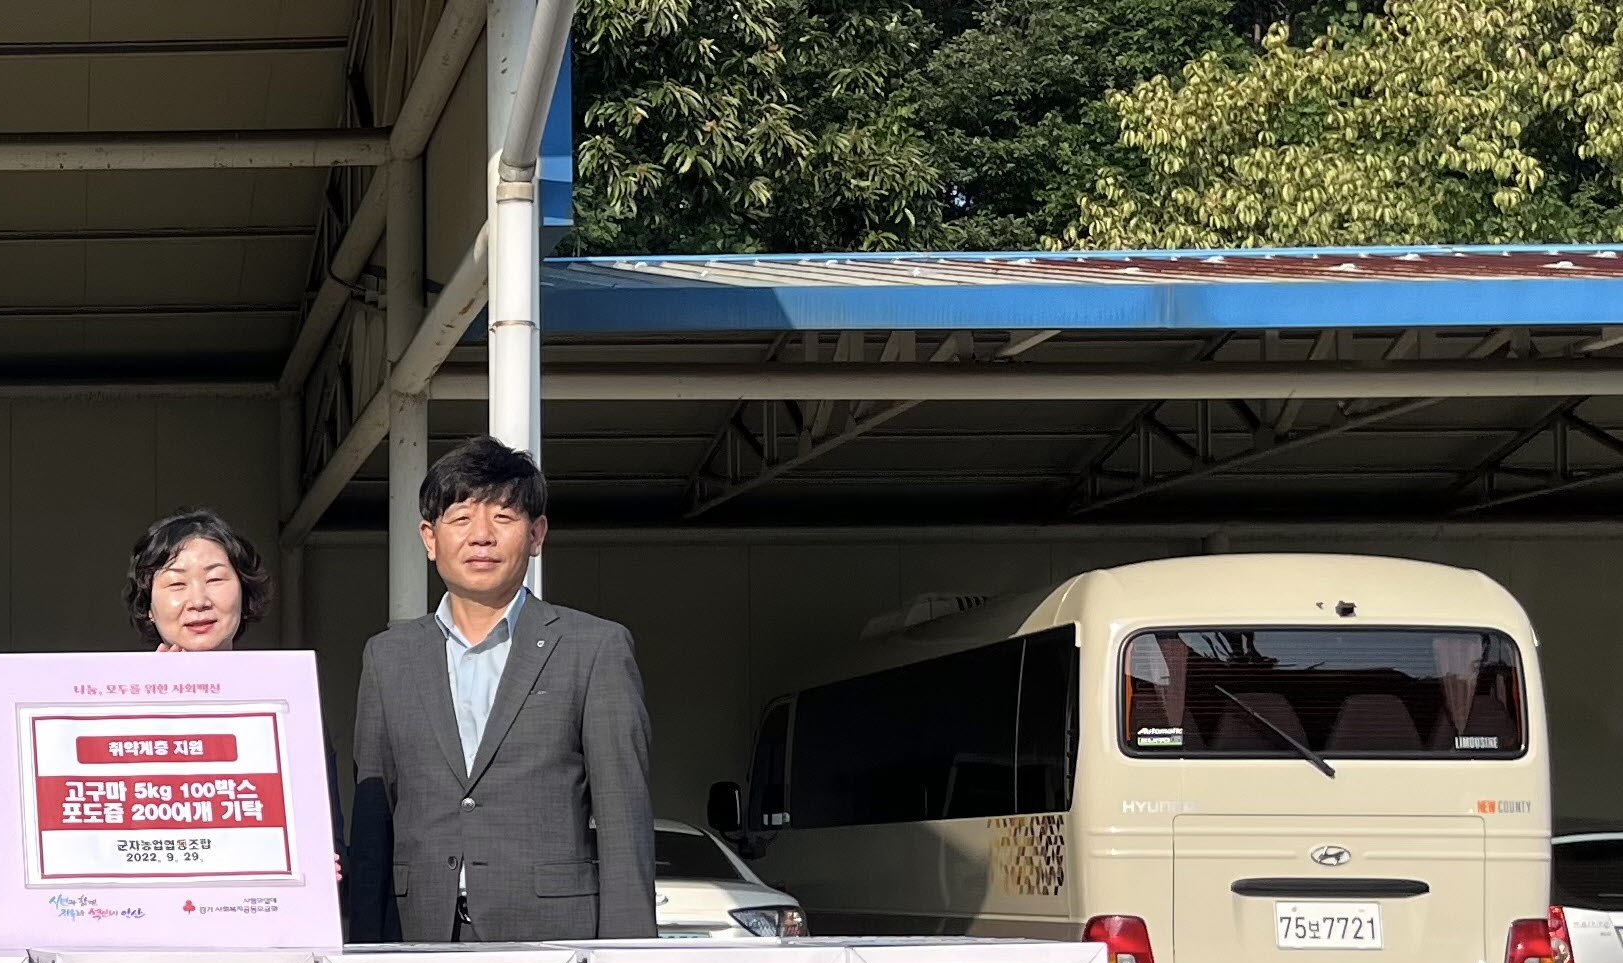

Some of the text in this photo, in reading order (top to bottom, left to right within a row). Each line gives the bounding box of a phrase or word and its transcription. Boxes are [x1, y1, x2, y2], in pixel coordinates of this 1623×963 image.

[106, 684, 140, 694] 모두를
[144, 683, 168, 694] 위한
[108, 740, 204, 756] 취약계층 지원
[1454, 736, 1498, 749] LIMOUSINE
[65, 779, 258, 802] 고구마 5kg 100박스
[62, 800, 264, 824] 포도즙 200여개 기탁
[1478, 800, 1531, 814] NEW COUNTY
[117, 838, 212, 852] 군자농업협동조합
[1279, 916, 1376, 940] 75보7721
